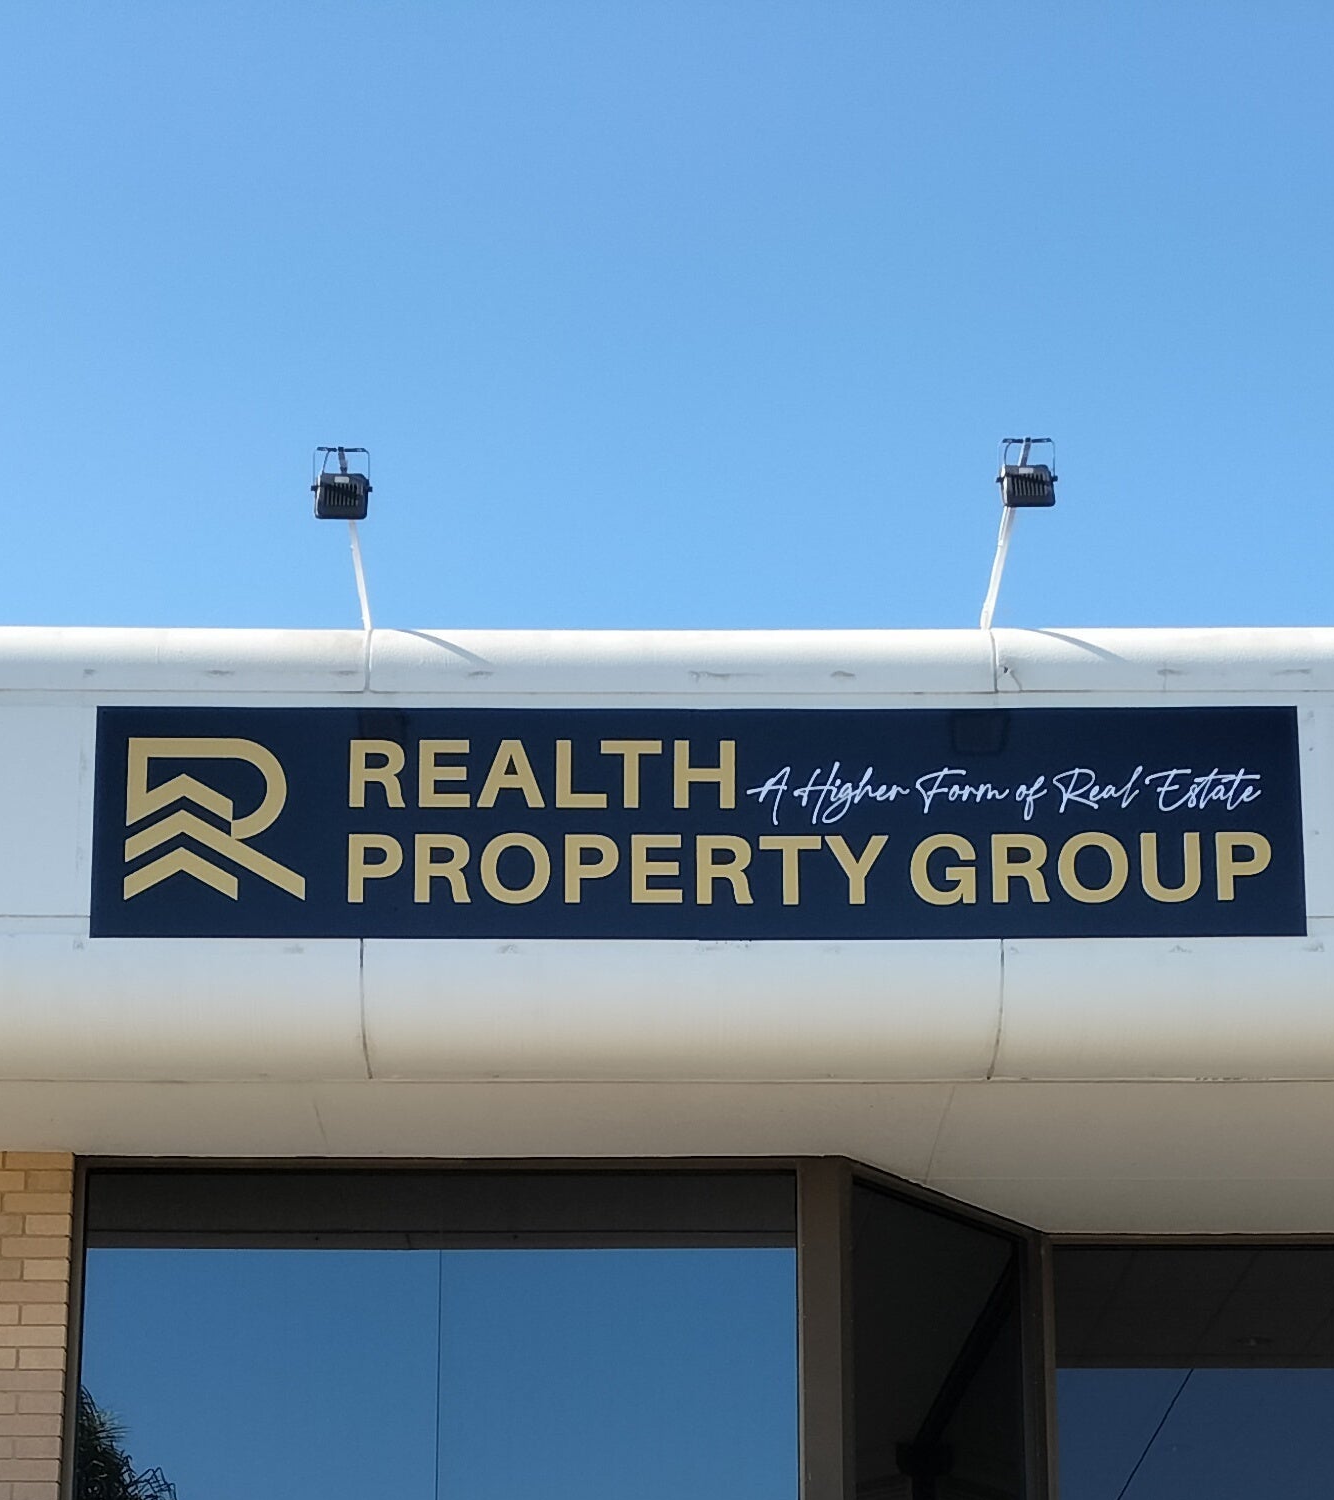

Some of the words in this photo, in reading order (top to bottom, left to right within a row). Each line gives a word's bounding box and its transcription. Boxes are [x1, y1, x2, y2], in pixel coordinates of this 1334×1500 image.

[347, 740, 736, 810] REALTH
[747, 767, 789, 824] A
[793, 762, 910, 823] Higher
[915, 769, 1011, 813] Form
[1016, 767, 1047, 820] of
[1052, 766, 1142, 810] Real
[1144, 770, 1263, 813] Estate
[347, 834, 889, 905] PROPERTY
[910, 831, 1272, 905] GROUP
